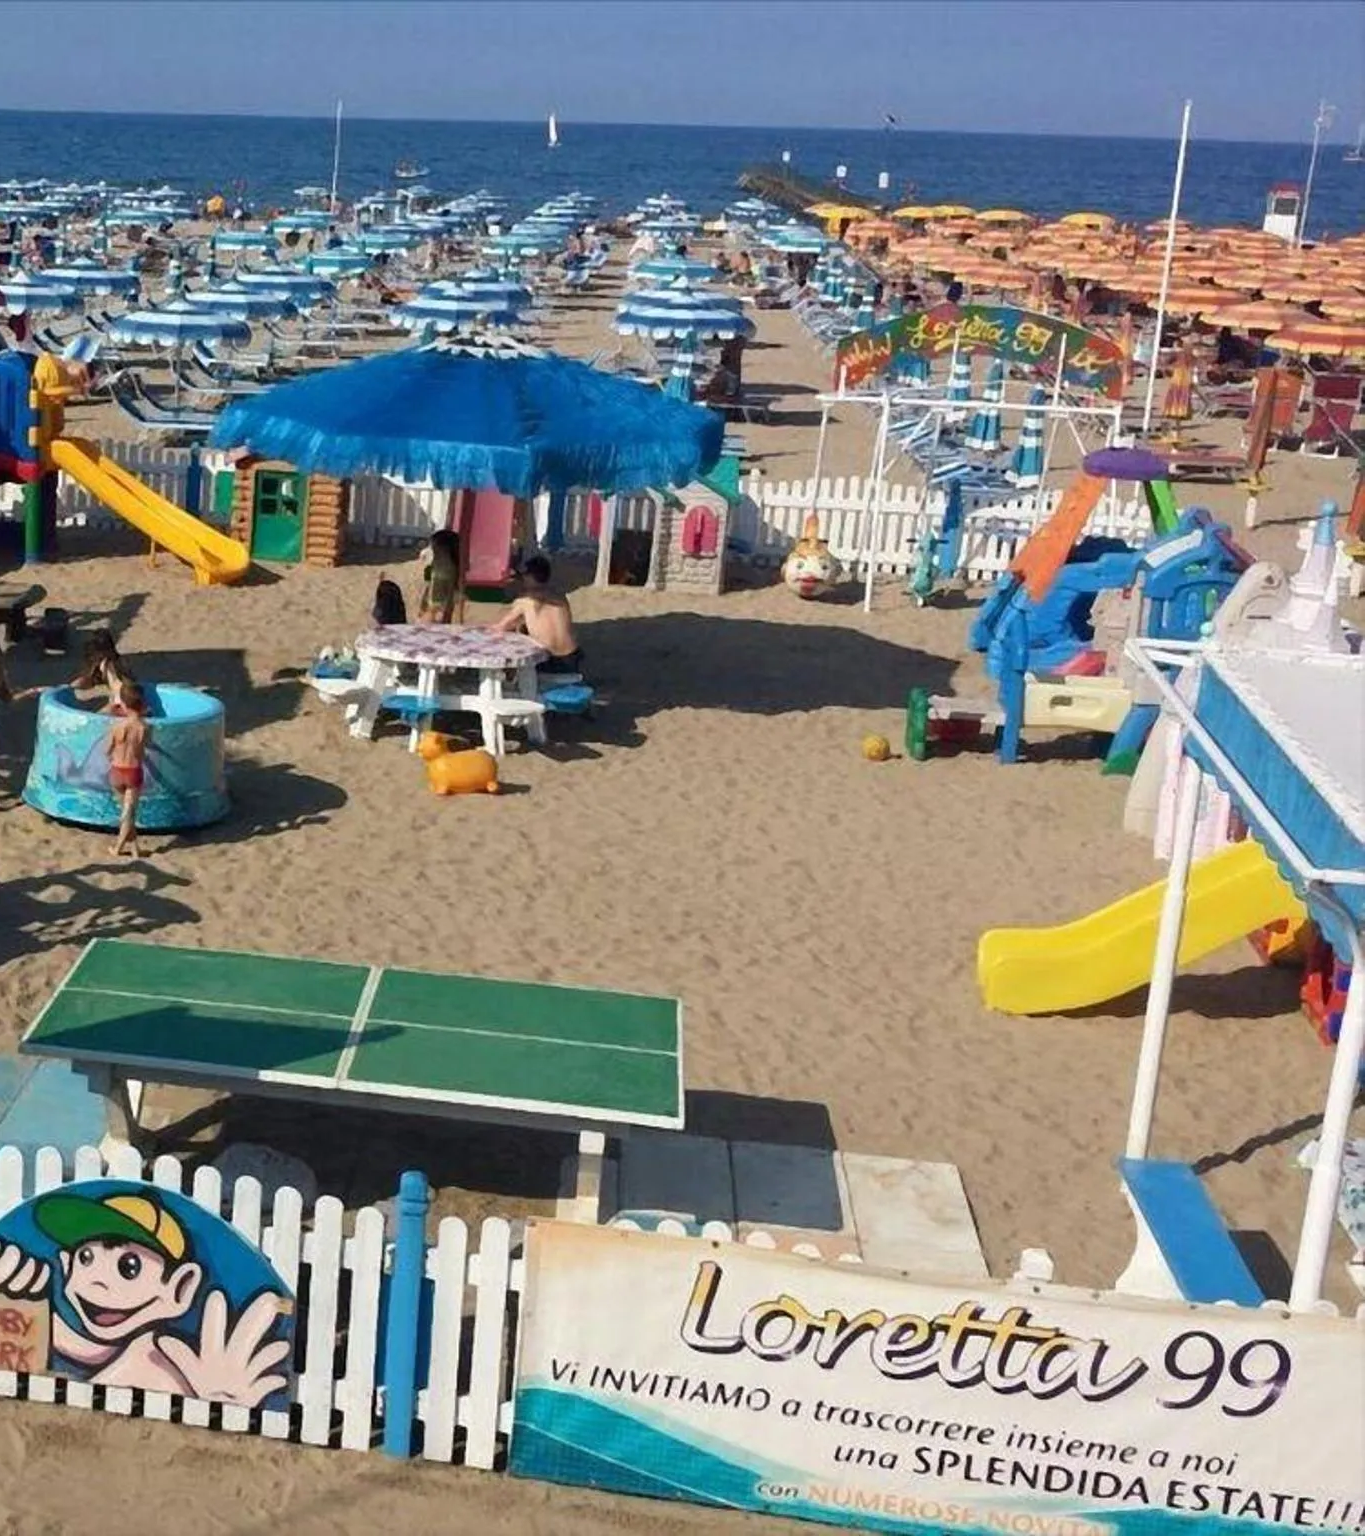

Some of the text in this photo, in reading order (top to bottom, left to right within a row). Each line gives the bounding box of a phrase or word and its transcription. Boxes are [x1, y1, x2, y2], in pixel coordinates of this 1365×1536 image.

[680, 1260, 1292, 1417] Loretta 99
[550, 1358, 1239, 1477] Vi INVITIAMO a trascorrere insieme a noi
[757, 1482, 799, 1499] con
[807, 1484, 978, 1523] NUMEROSE
[834, 1445, 899, 1471] una
[912, 1446, 1151, 1506] SPLENDIDA
